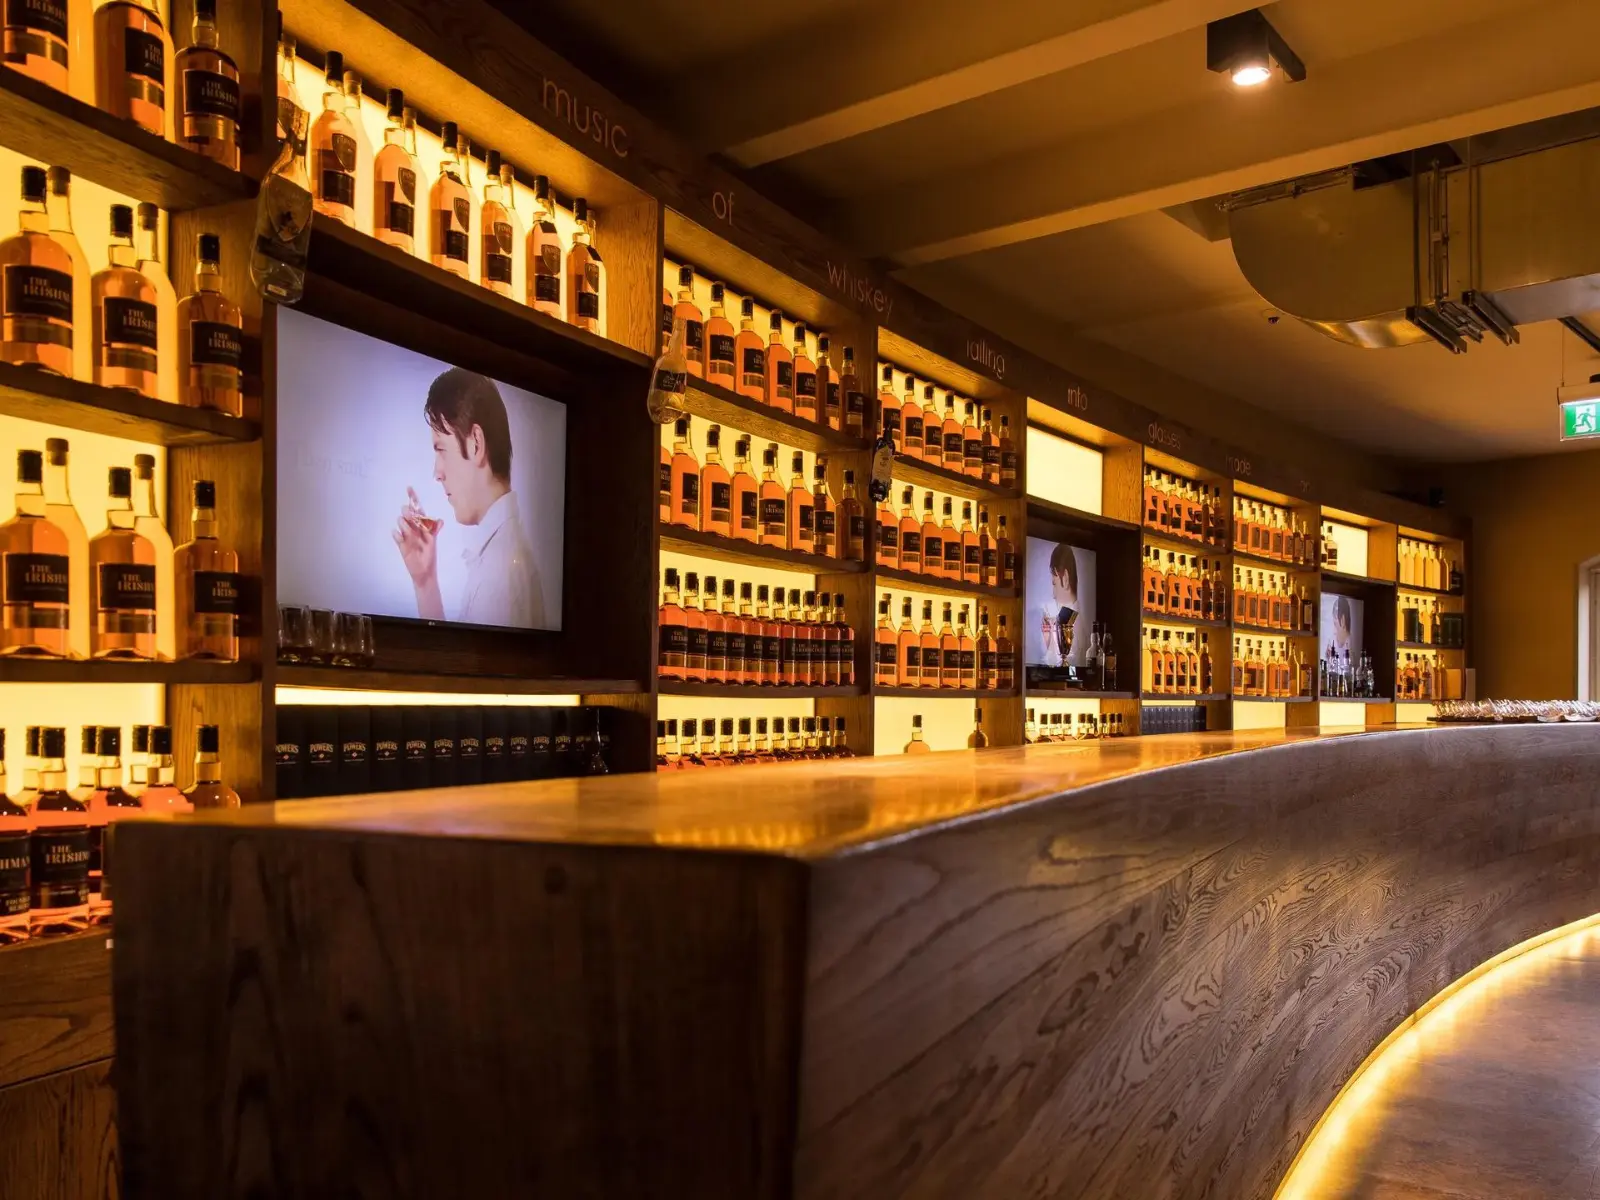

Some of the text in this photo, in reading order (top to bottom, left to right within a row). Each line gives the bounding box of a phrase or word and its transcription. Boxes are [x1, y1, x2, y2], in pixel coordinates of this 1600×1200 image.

[543, 77, 628, 158] music
[712, 191, 735, 226] of
[827, 260, 894, 323] whiskey
[1067, 386, 1088, 411] into
[30, 276, 48, 286] THE
[30, 564, 51, 573] THE
[122, 573, 141, 582] THE
[343, 741, 366, 752] POWERS
[376, 740, 398, 751] POWERS
[406, 739, 427, 750] POWERS
[434, 738, 454, 749] POWERS
[461, 737, 480, 748] POWERS
[486, 736, 504, 747] POWERS
[310, 742, 334, 753] POWERS
[52, 845, 71, 854] THE
